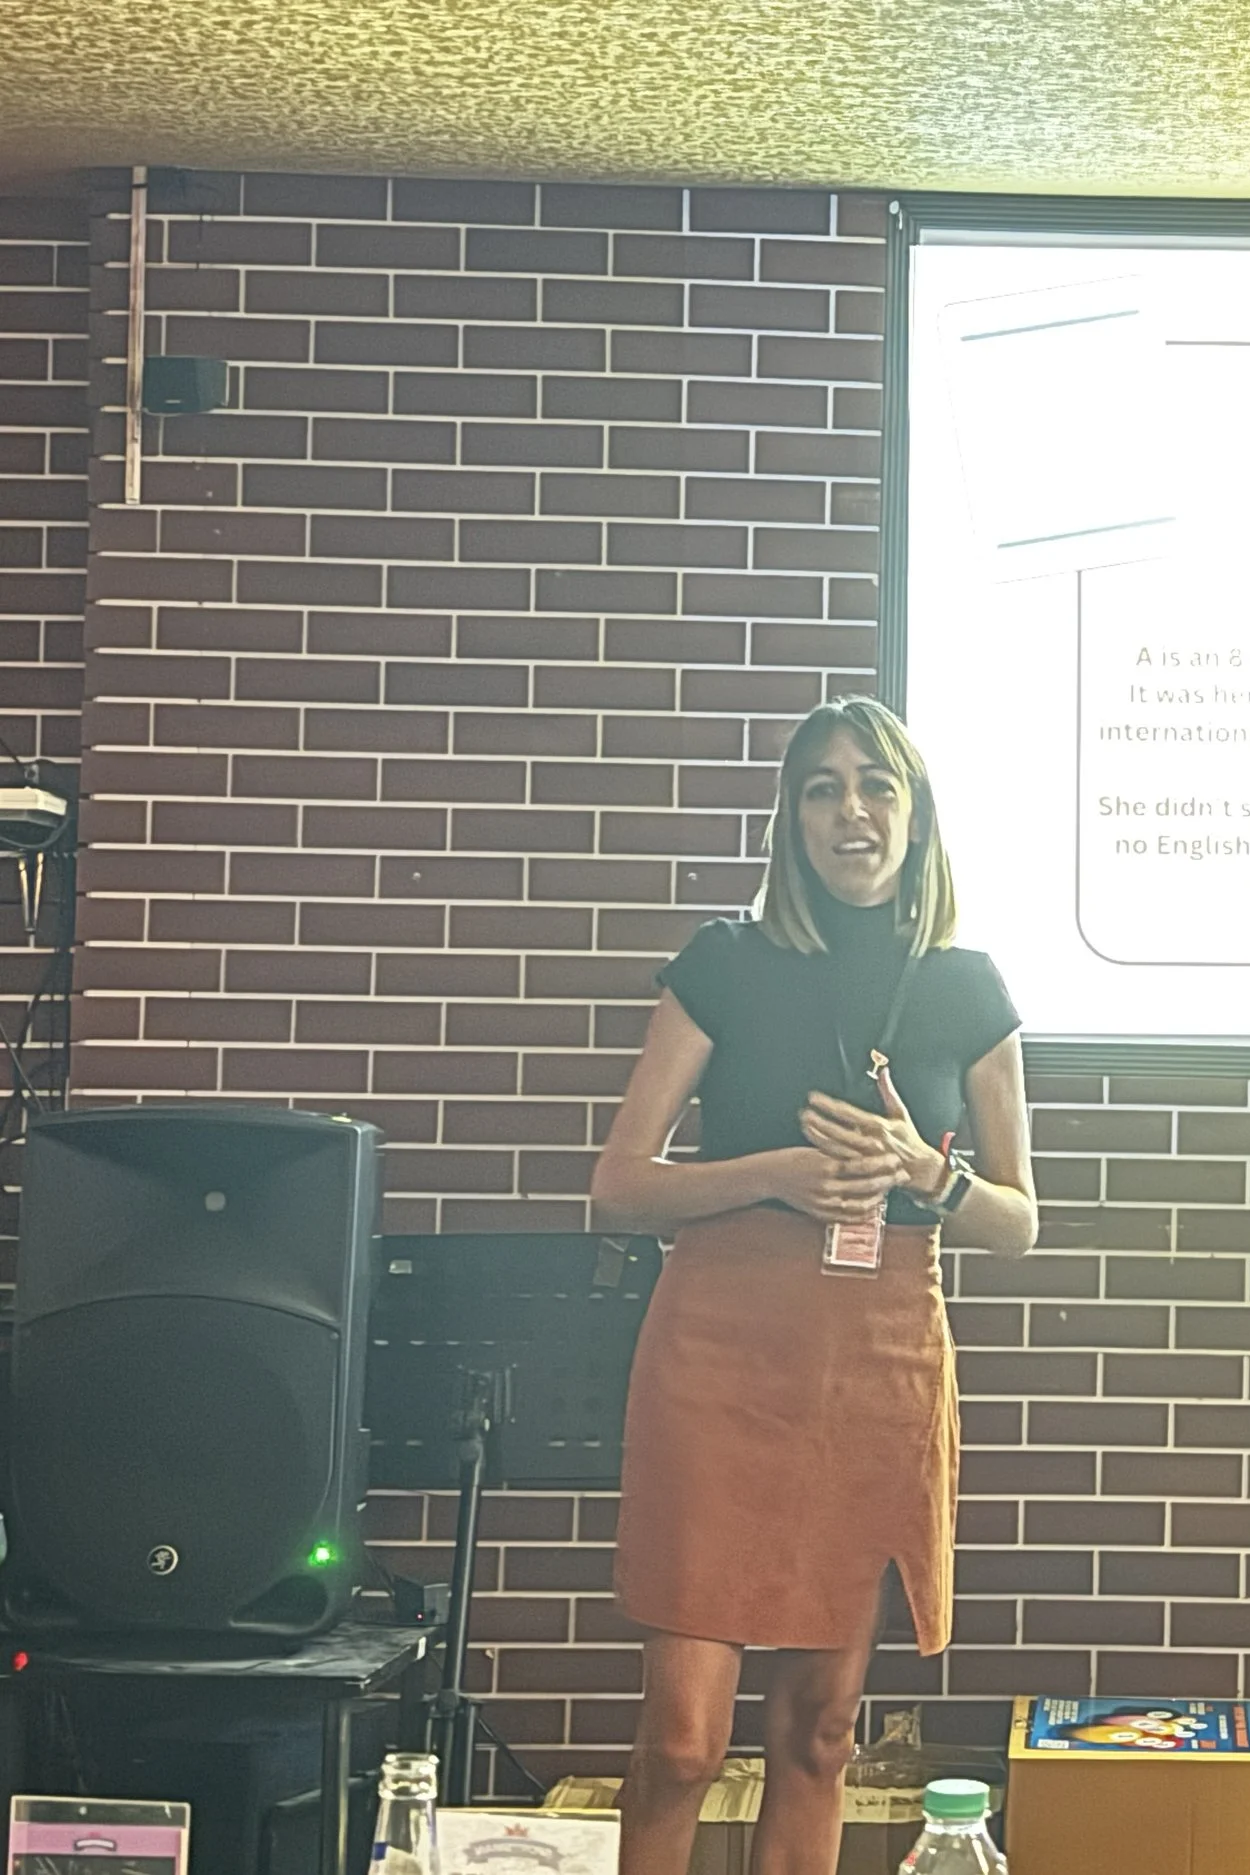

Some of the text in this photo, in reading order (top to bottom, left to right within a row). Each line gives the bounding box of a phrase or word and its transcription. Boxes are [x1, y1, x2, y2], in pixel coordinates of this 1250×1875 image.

[1136, 645, 1153, 668] A
[1162, 646, 1181, 668] is
[1190, 650, 1221, 669] an
[1228, 648, 1243, 668] 8
[1128, 684, 1149, 705] It
[1156, 687, 1205, 705] was
[1098, 796, 1148, 817] She
[1116, 838, 1148, 856] no
[1158, 835, 1250, 861] English
